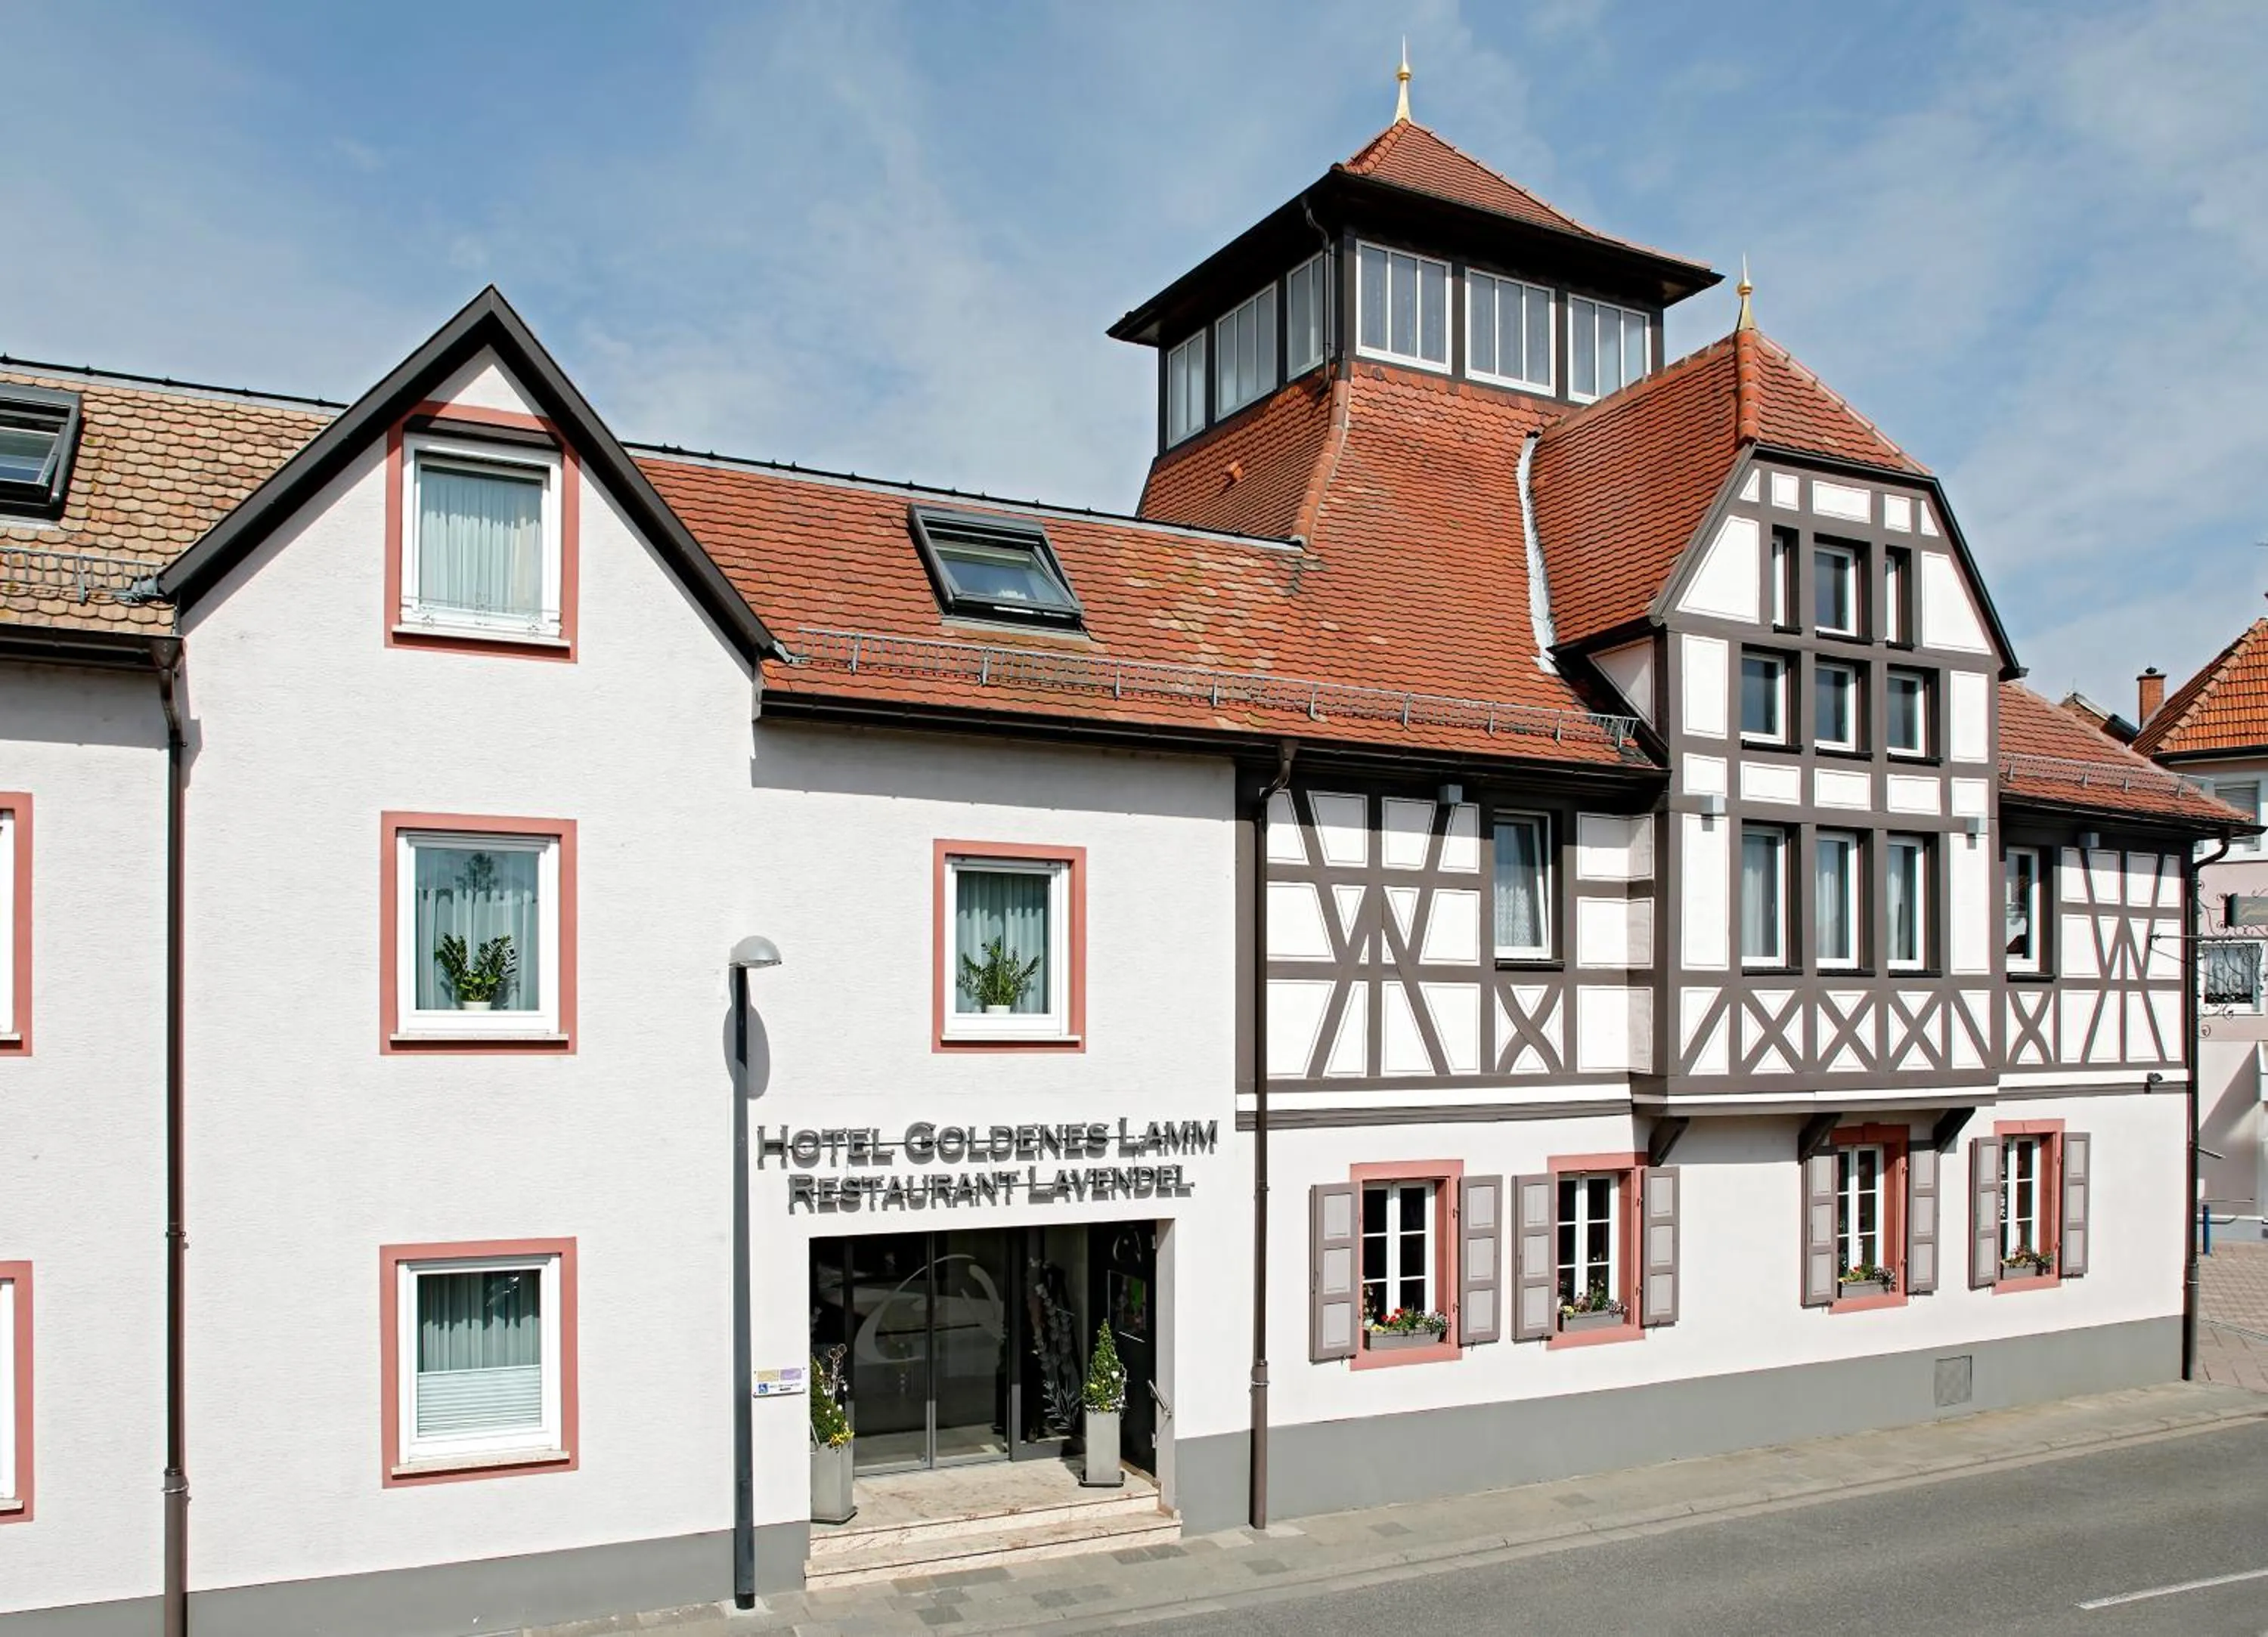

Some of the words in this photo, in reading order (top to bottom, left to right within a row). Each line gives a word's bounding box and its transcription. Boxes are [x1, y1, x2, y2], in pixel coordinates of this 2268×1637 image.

[757, 1125, 895, 1162] HOTEL
[905, 1122, 1110, 1159] GOLDENES
[1118, 1117, 1218, 1150] LAMM
[788, 1170, 1020, 1206] RESTAURANT
[1028, 1164, 1195, 1196] LAVENDEL
